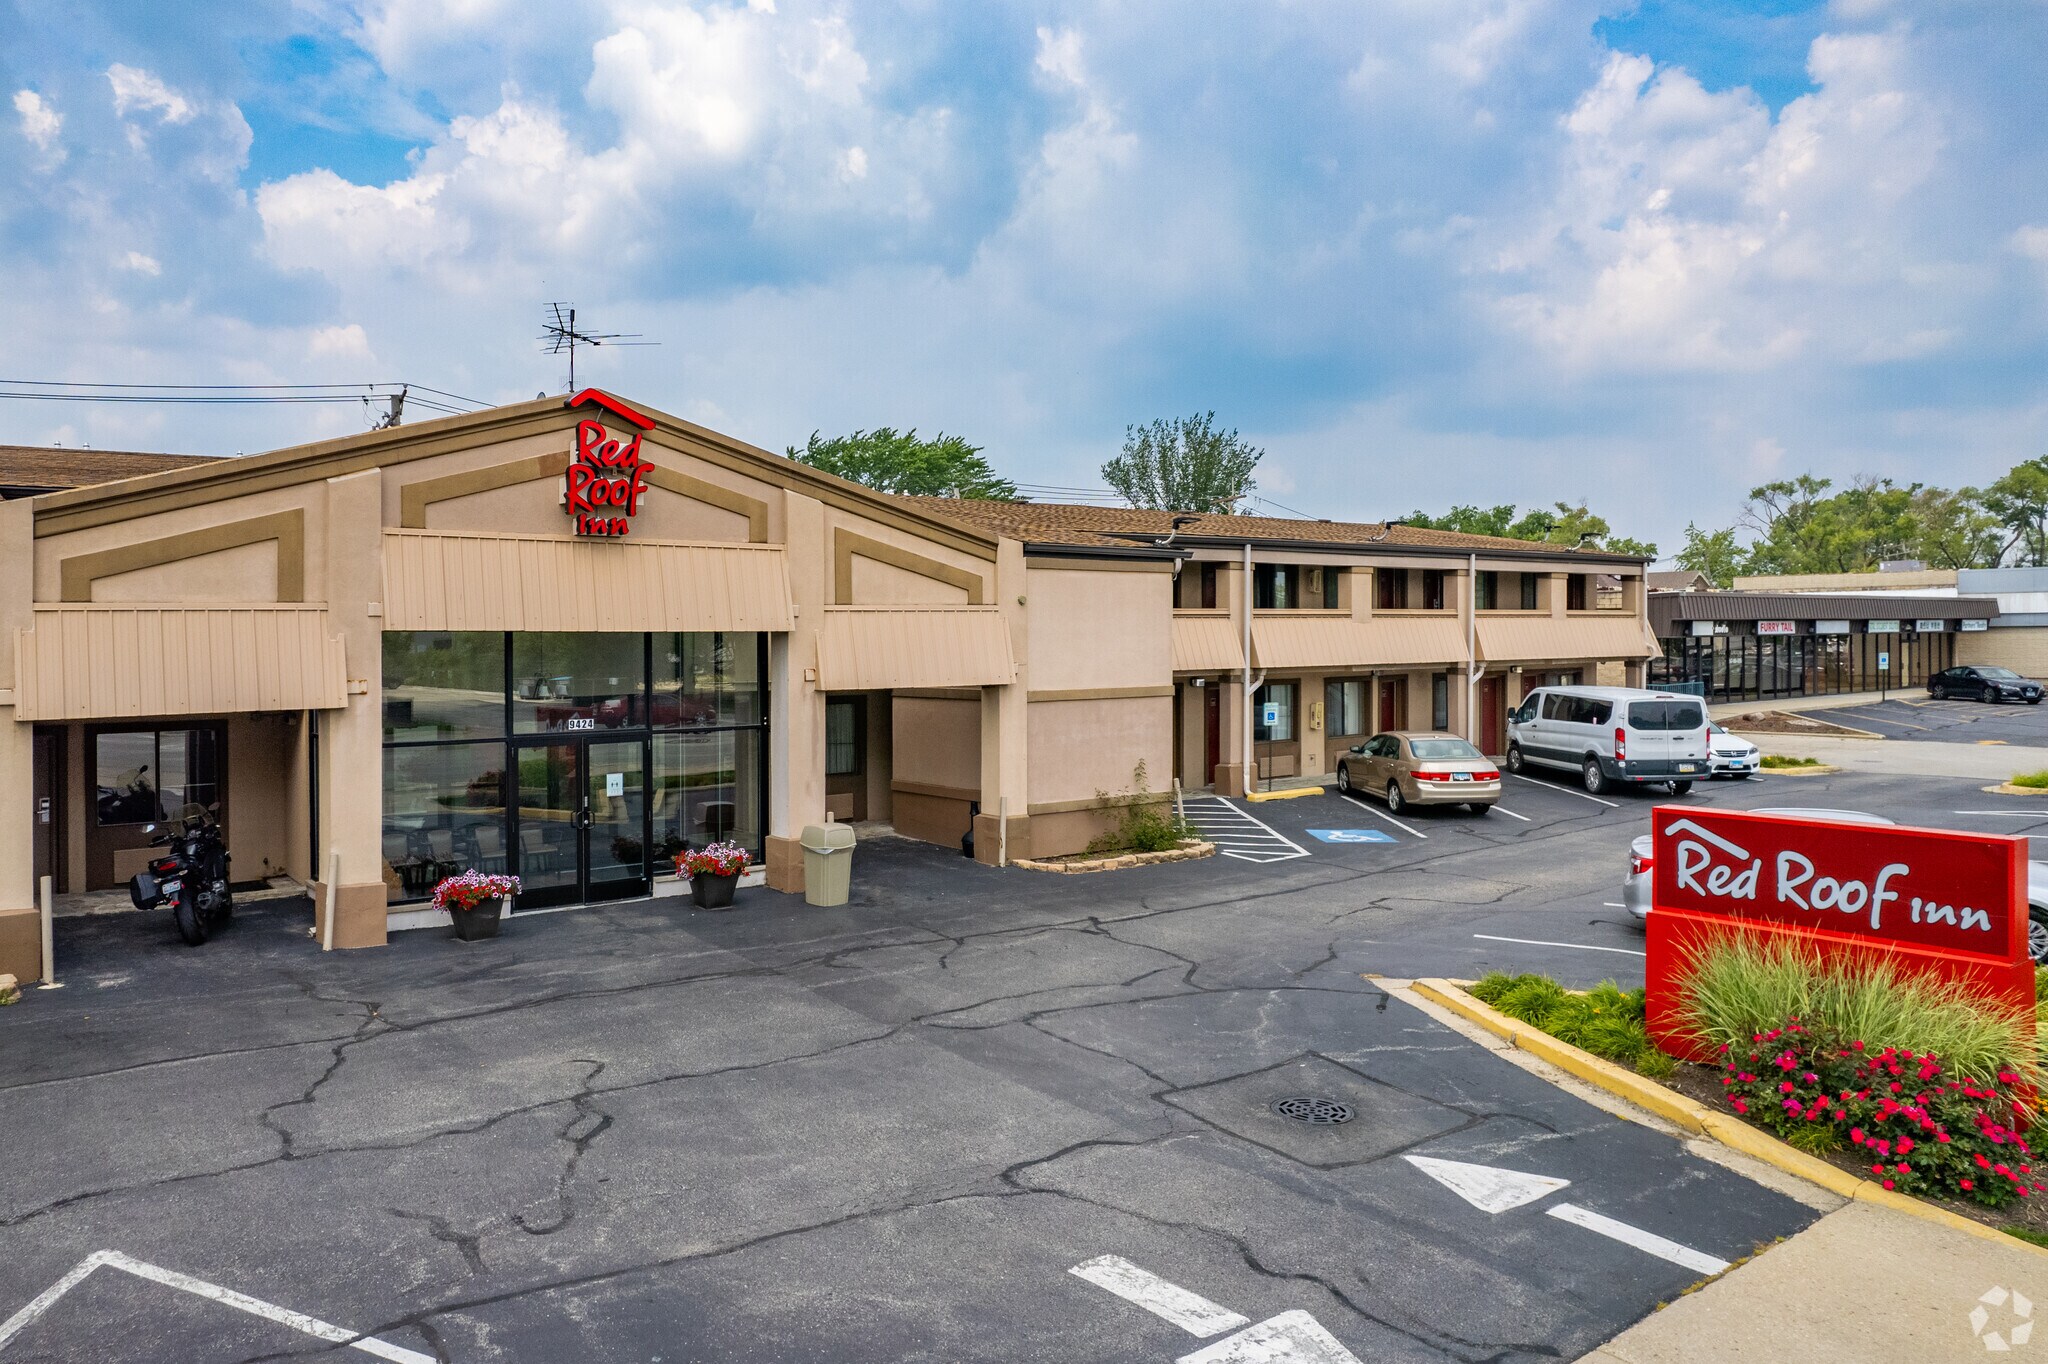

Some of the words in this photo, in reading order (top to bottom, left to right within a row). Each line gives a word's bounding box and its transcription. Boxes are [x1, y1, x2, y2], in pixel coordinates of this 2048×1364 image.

[576, 420, 642, 468] Red
[565, 463, 655, 517] Roof
[1760, 622, 1779, 632] FURRY
[1780, 622, 1793, 632] TAIL
[569, 719, 593, 729] 9424
[1677, 839, 1762, 900] Red
[1776, 850, 1910, 930] Roof
